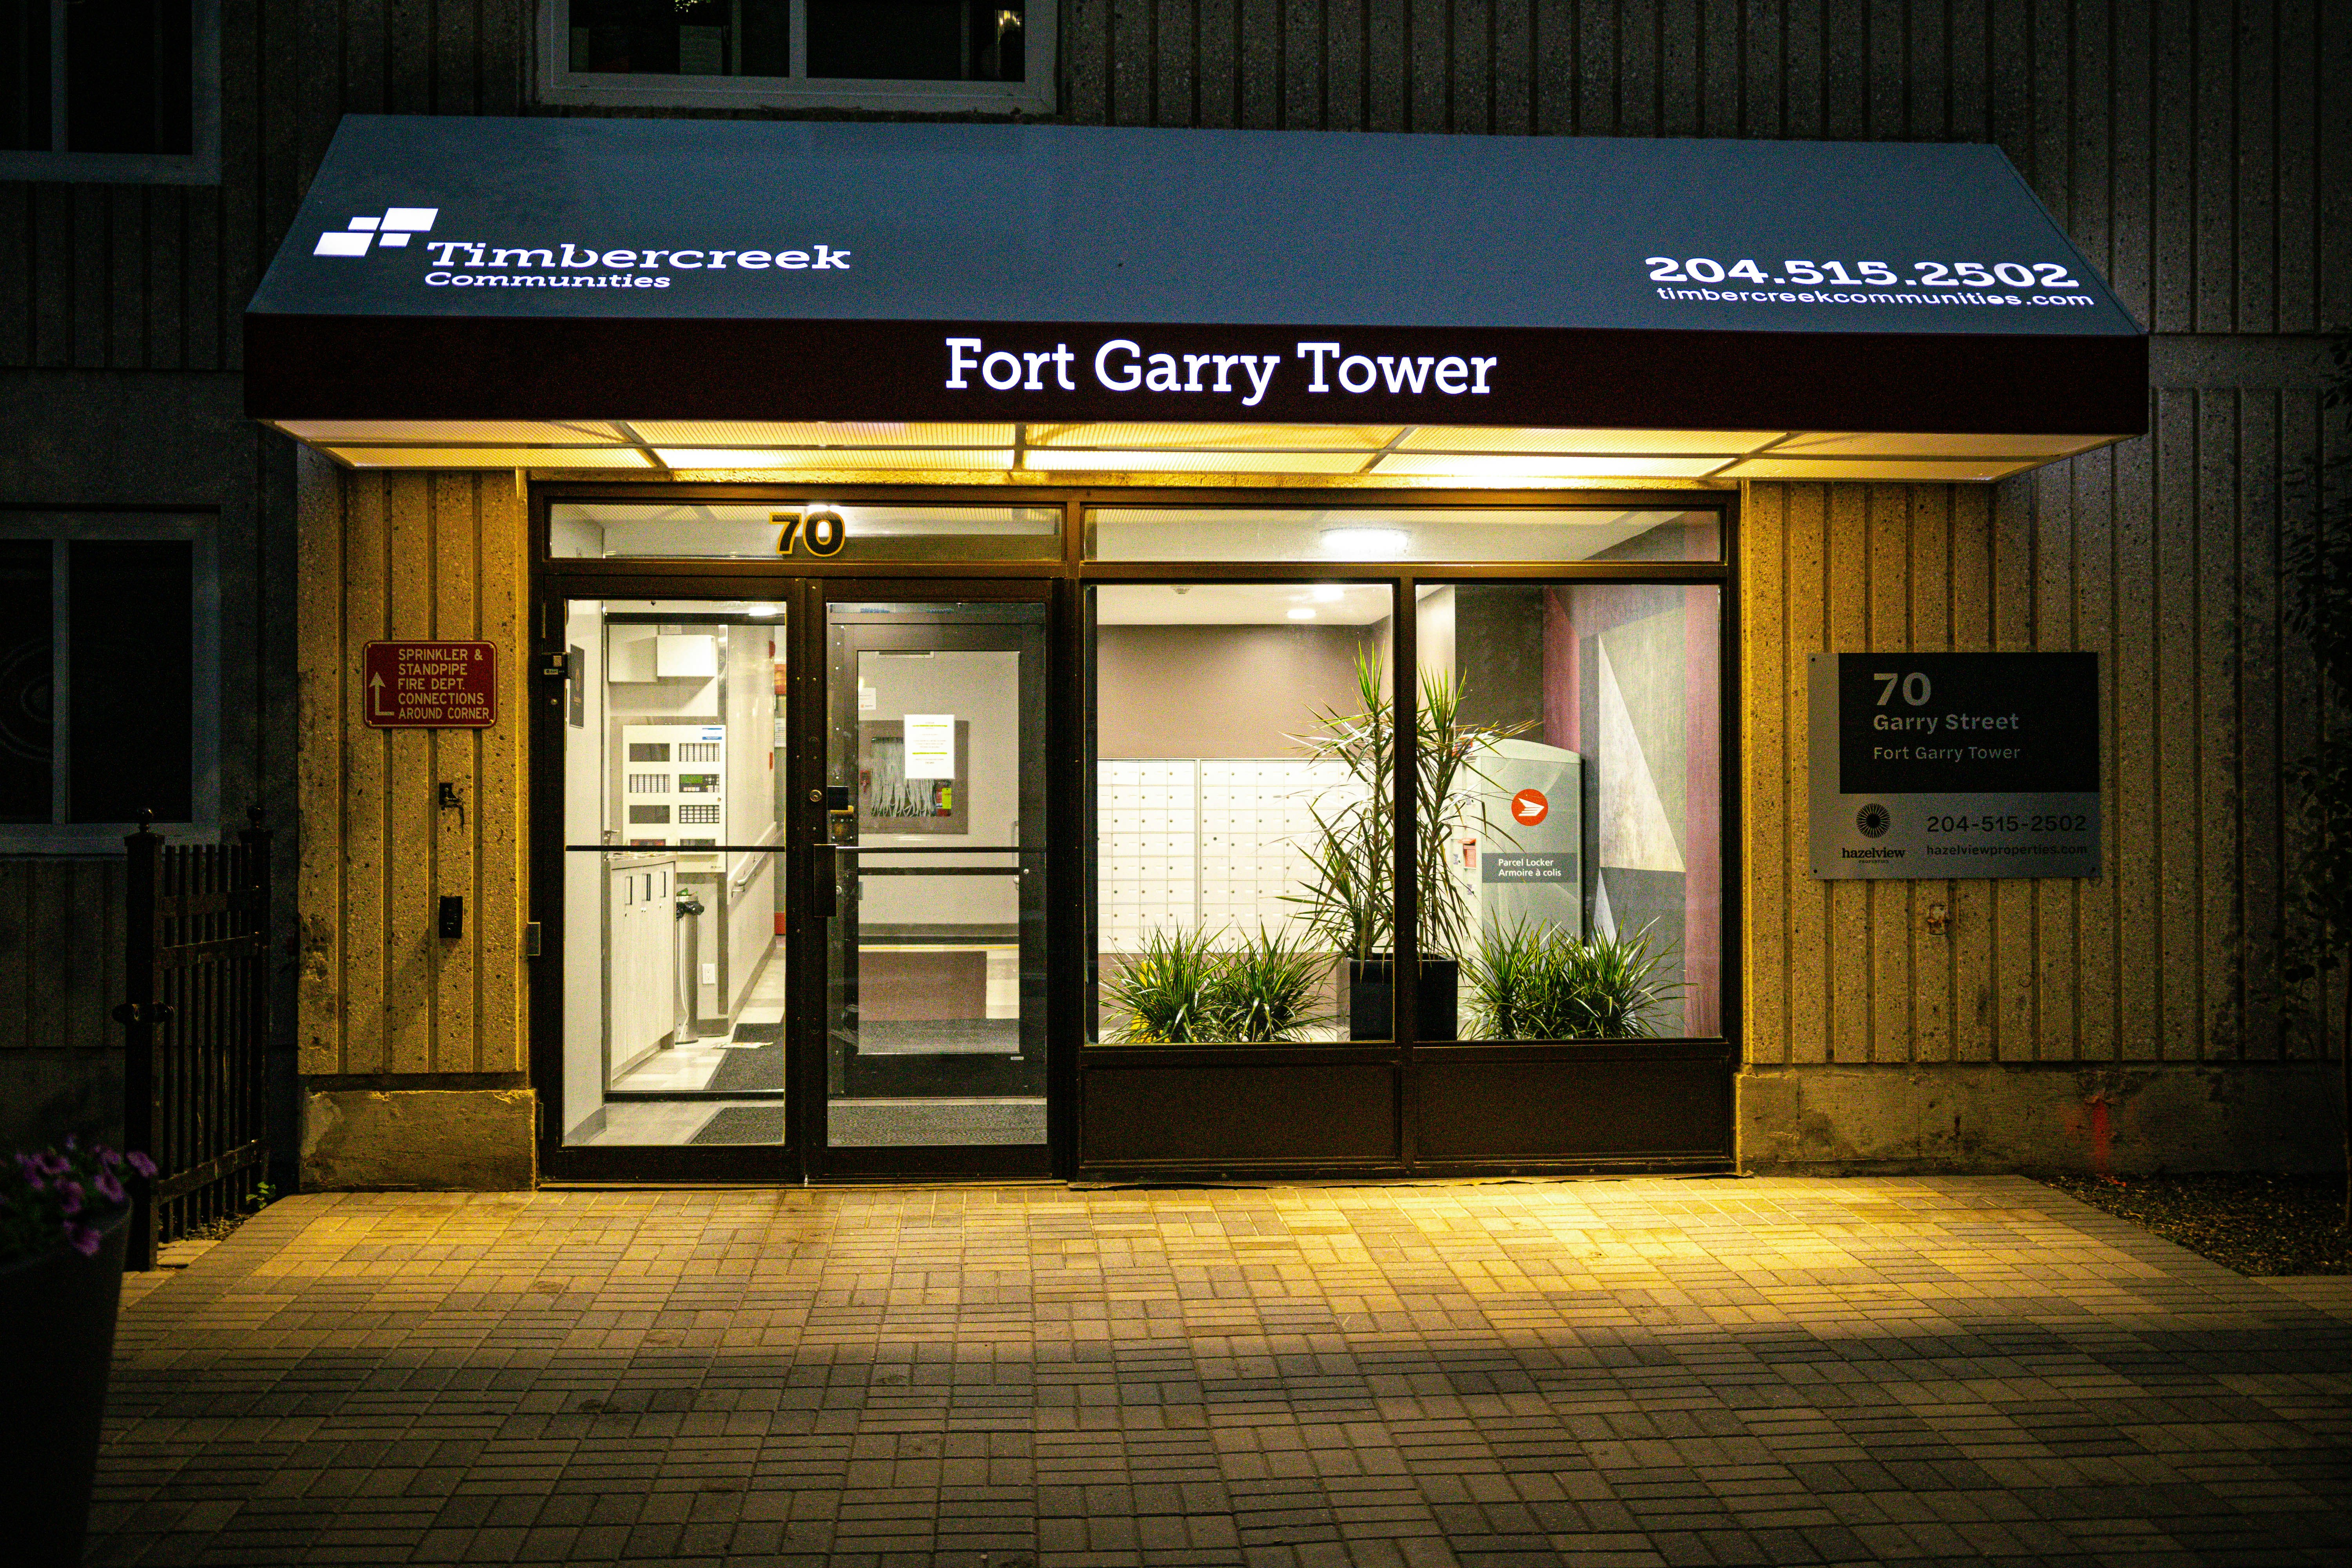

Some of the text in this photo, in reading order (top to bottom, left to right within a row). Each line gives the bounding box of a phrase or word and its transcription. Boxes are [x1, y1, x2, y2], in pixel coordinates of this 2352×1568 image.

[427, 242, 851, 269] Timbercreek
[1644, 256, 2080, 287] 204.515.2502
[425, 272, 670, 288] Communities
[1657, 287, 2094, 305] timbercreekcommunities.com
[946, 338, 1497, 406] Fort Garry Tower
[769, 510, 845, 557] 70
[399, 648, 483, 661] SPRINKLER &
[399, 663, 467, 675] STANDPIPE
[398, 678, 465, 690] FIRE DEPT.
[1874, 672, 1931, 706] 70
[399, 692, 484, 705] CONNECTIONS
[399, 707, 489, 719] AROUND CORNER
[1873, 713, 2018, 734] Garry Street
[1874, 746, 2020, 762] Fort Garry Tower
[1927, 815, 2087, 832] 204-515-2502
[1842, 847, 1906, 858] hazelview
[1927, 844, 2087, 856] hazelviewproperties.com
